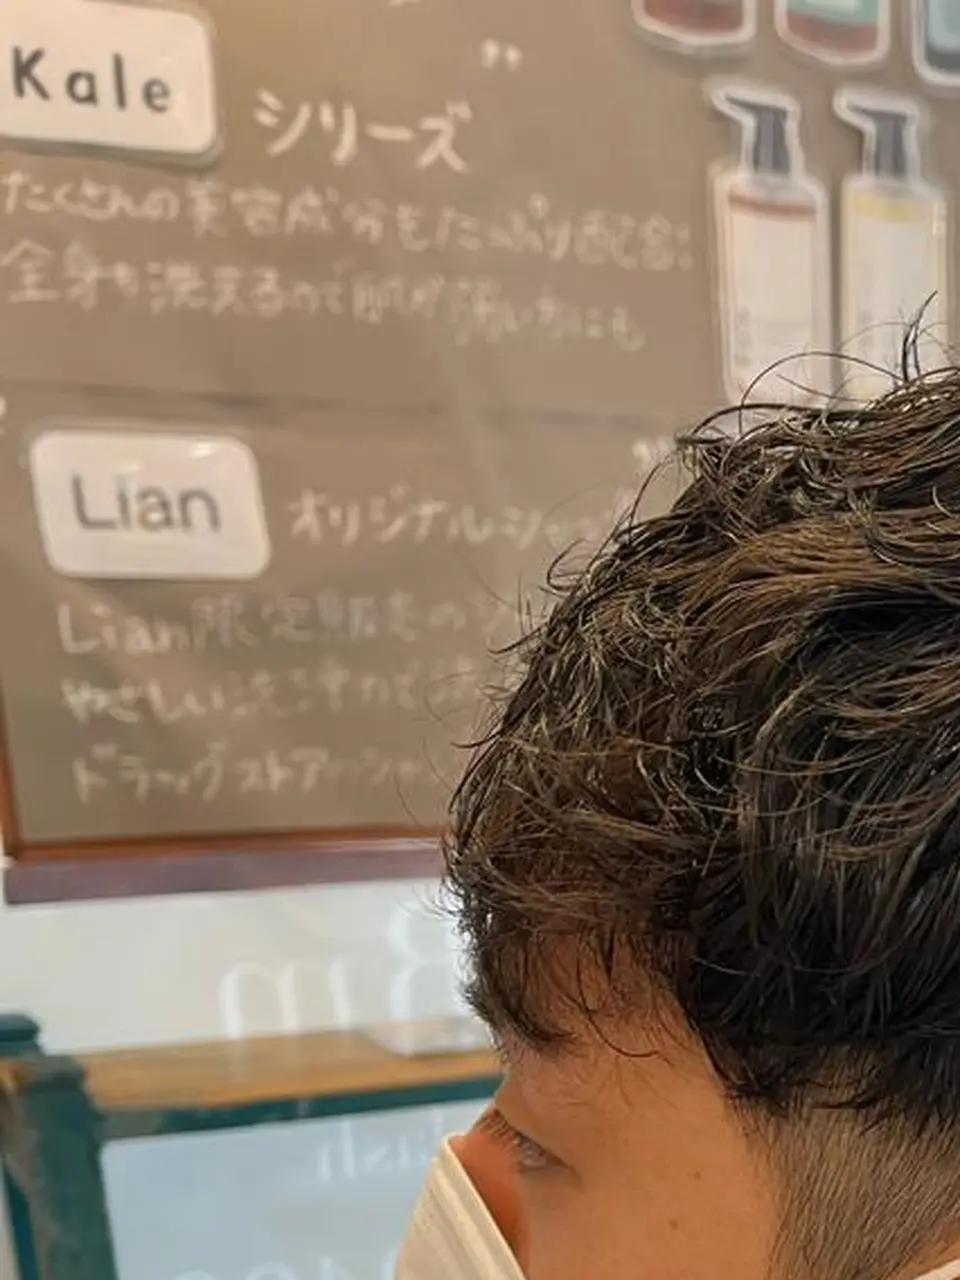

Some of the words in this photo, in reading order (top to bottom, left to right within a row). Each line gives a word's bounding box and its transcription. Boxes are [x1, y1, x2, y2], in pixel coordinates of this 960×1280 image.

[11, 46, 172, 113] Kale
[253, 88, 473, 173] シリーズ
[70, 473, 222, 533] Lian
